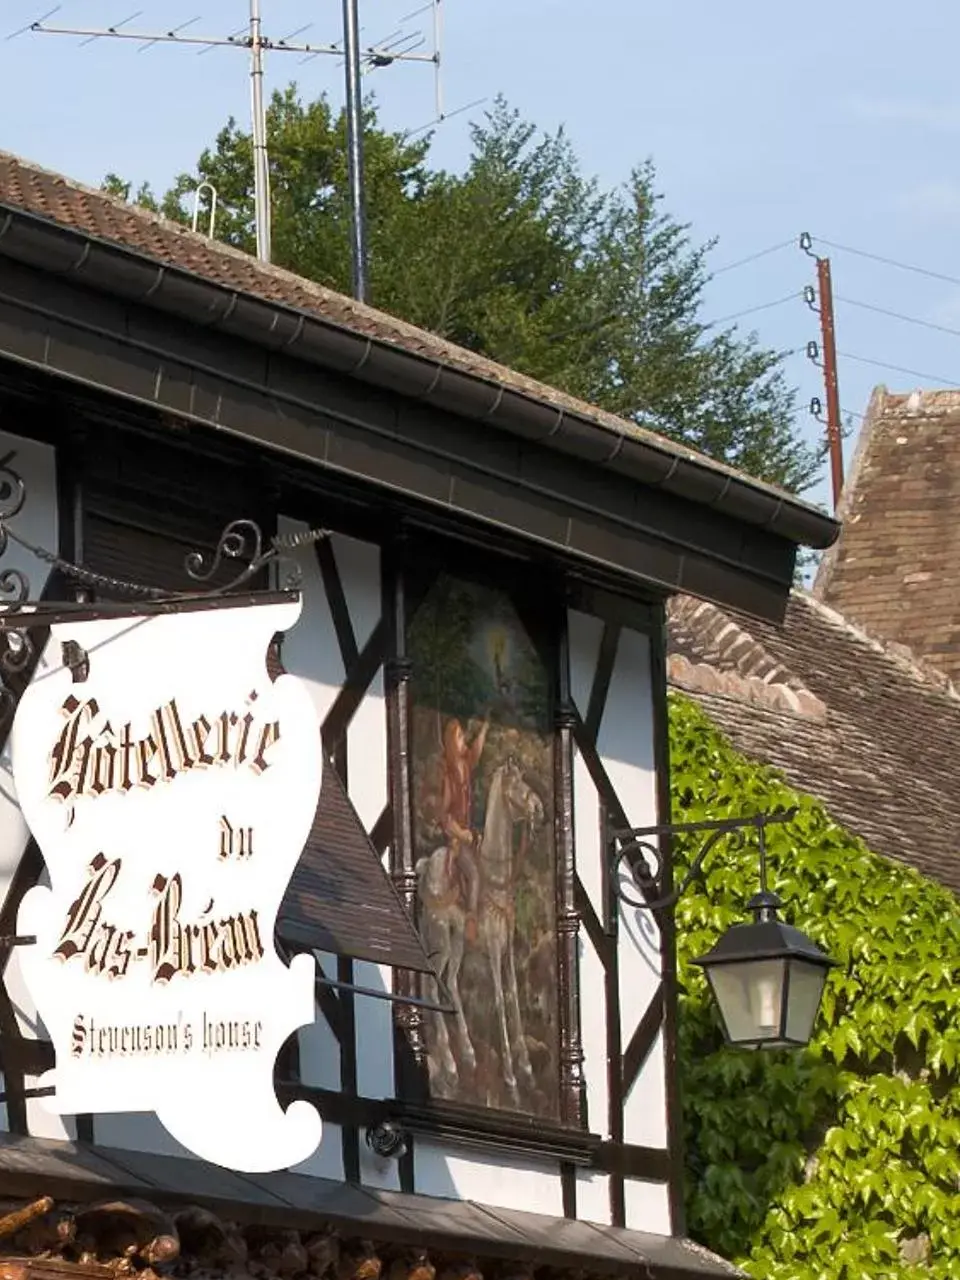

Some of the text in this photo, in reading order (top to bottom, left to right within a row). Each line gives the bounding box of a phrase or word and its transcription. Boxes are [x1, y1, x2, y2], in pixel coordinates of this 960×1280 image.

[216, 814, 253, 860] du
[72, 1011, 262, 1058] Stevenson's house
